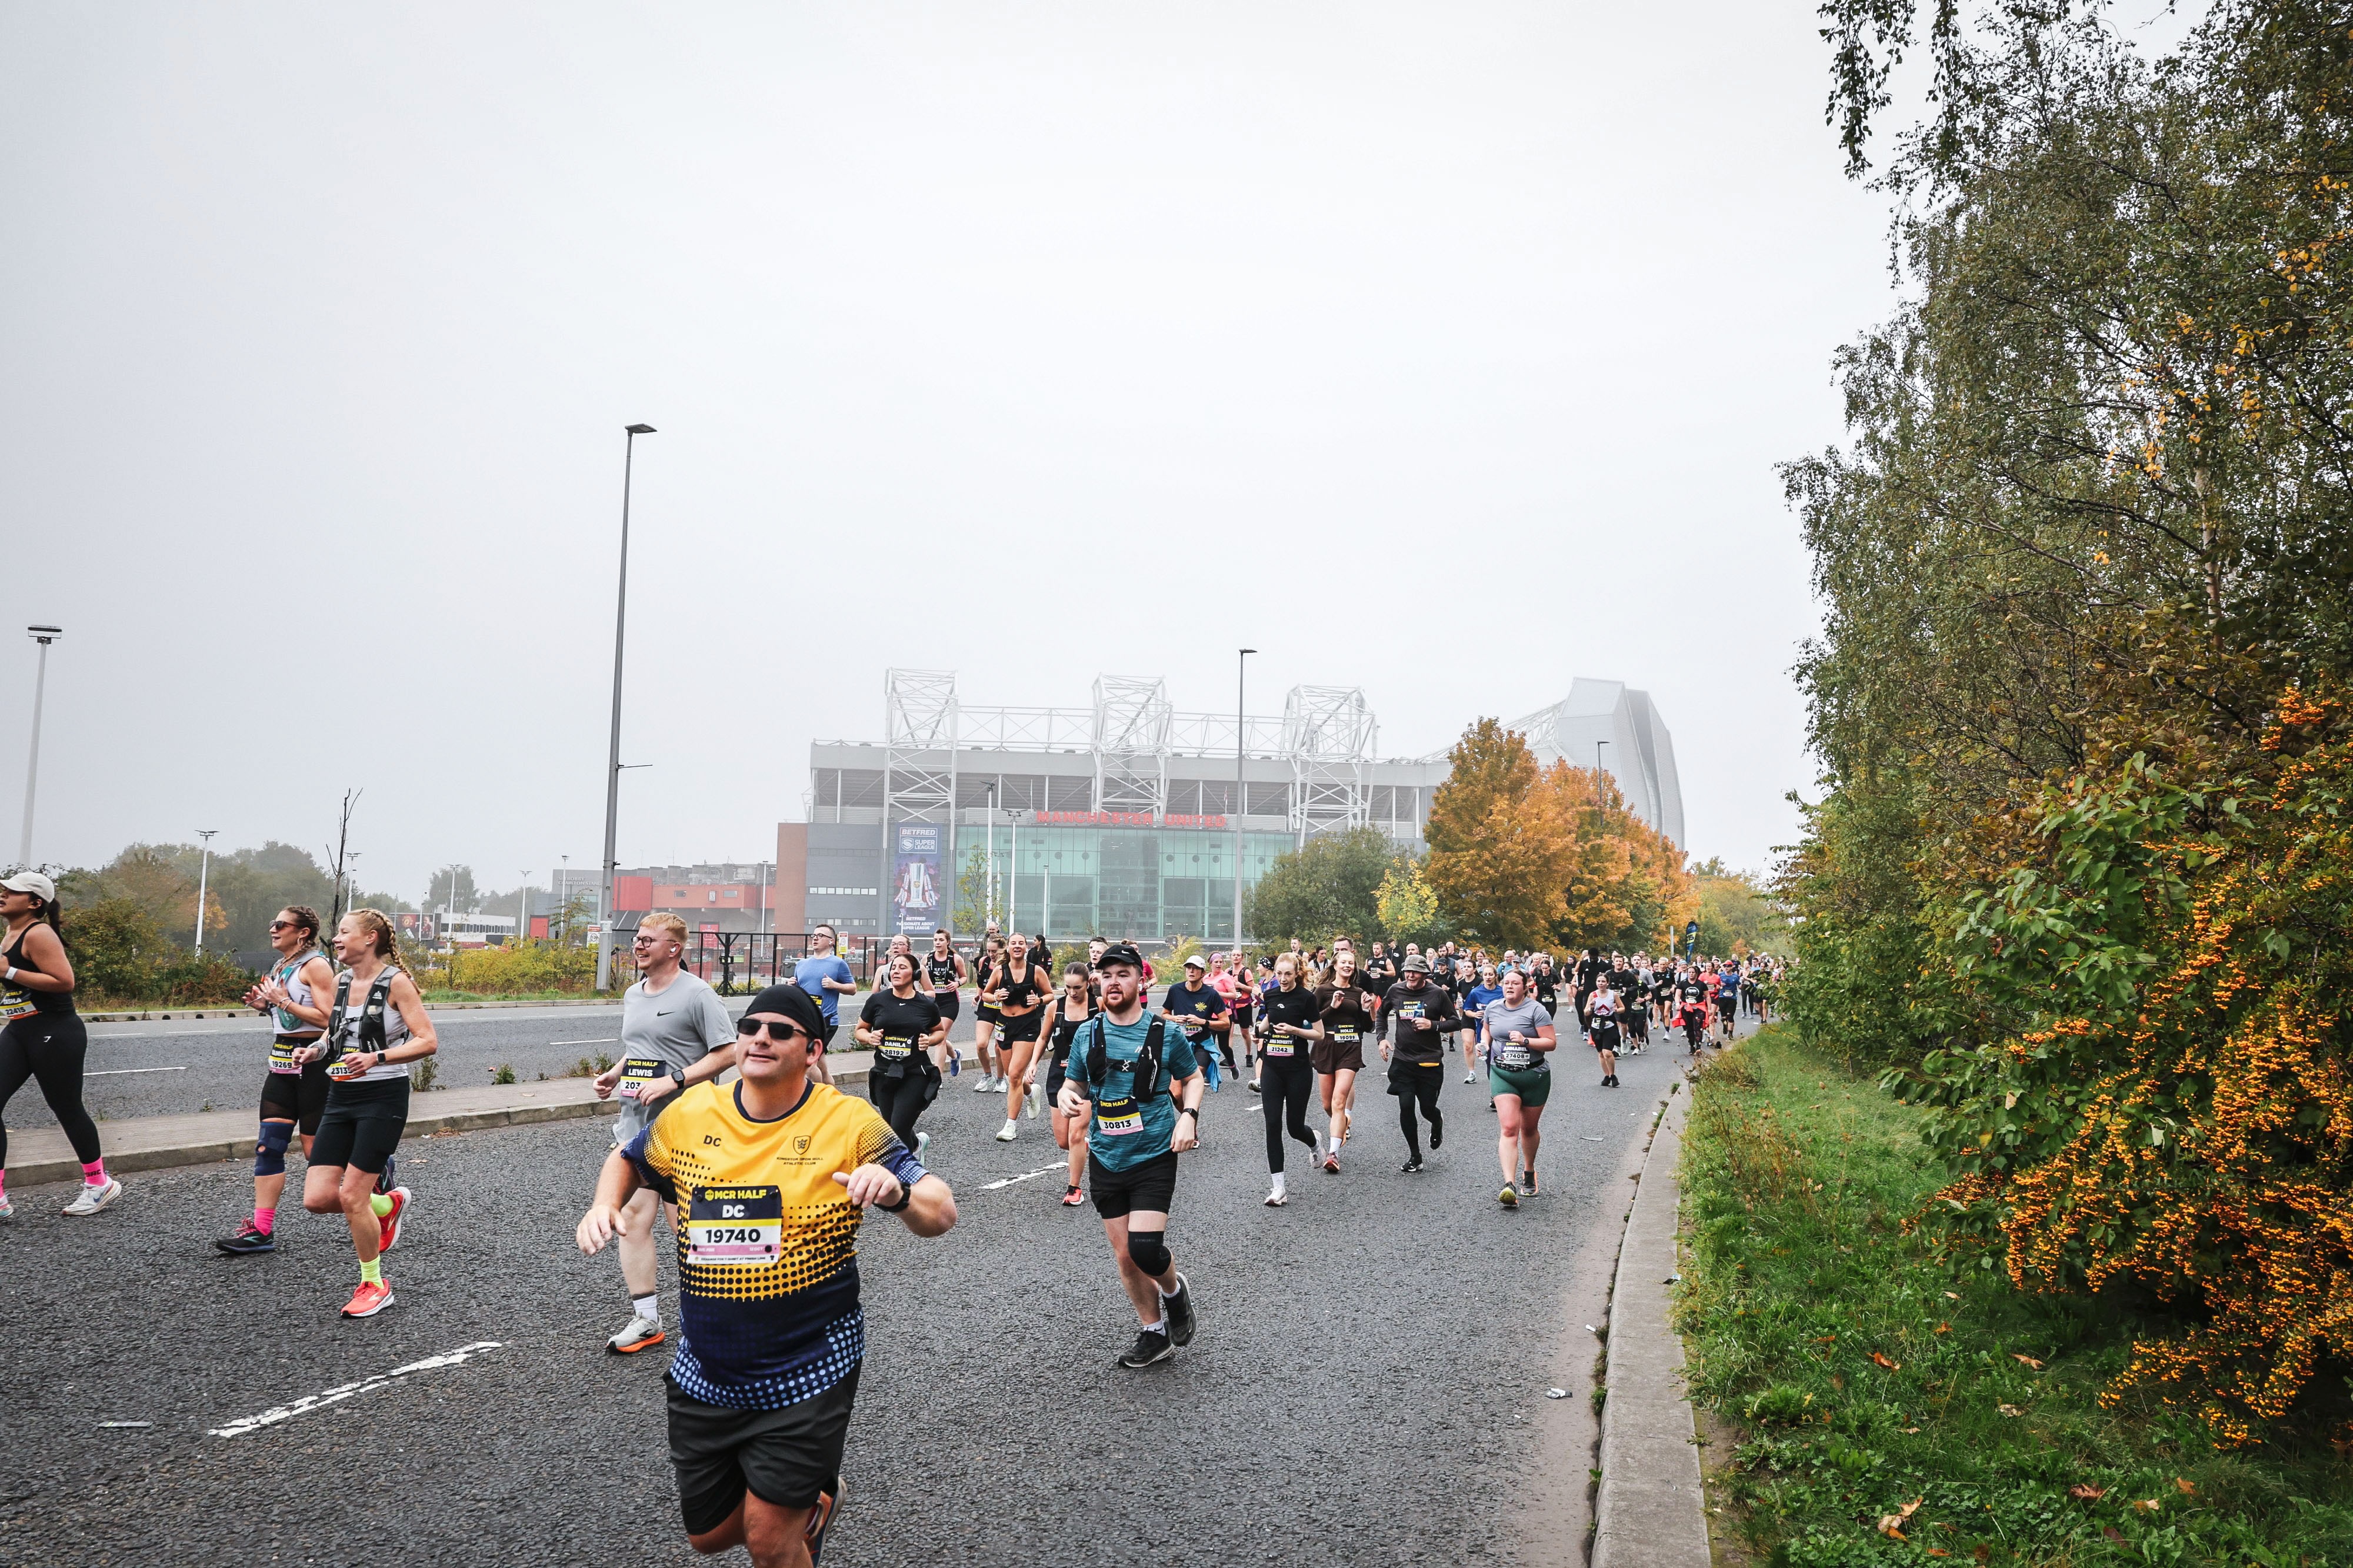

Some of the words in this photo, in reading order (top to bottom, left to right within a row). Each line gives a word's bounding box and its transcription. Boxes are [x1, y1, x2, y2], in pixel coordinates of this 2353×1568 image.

[1036, 810, 1152, 825] MANCHESTER
[1164, 813, 1227, 827] UNITED
[5, 1007, 26, 1015] 22415
[272, 1060, 292, 1069] 19269
[628, 1068, 654, 1077] LEWIS
[625, 1081, 641, 1090] 203
[1112, 1099, 1128, 1107] HALF
[1104, 1119, 1132, 1129] 30813
[704, 1135, 722, 1147] DC
[714, 1190, 736, 1200] MCR
[737, 1189, 767, 1199] HALF
[722, 1205, 745, 1218] DC
[705, 1228, 761, 1244] 19740
